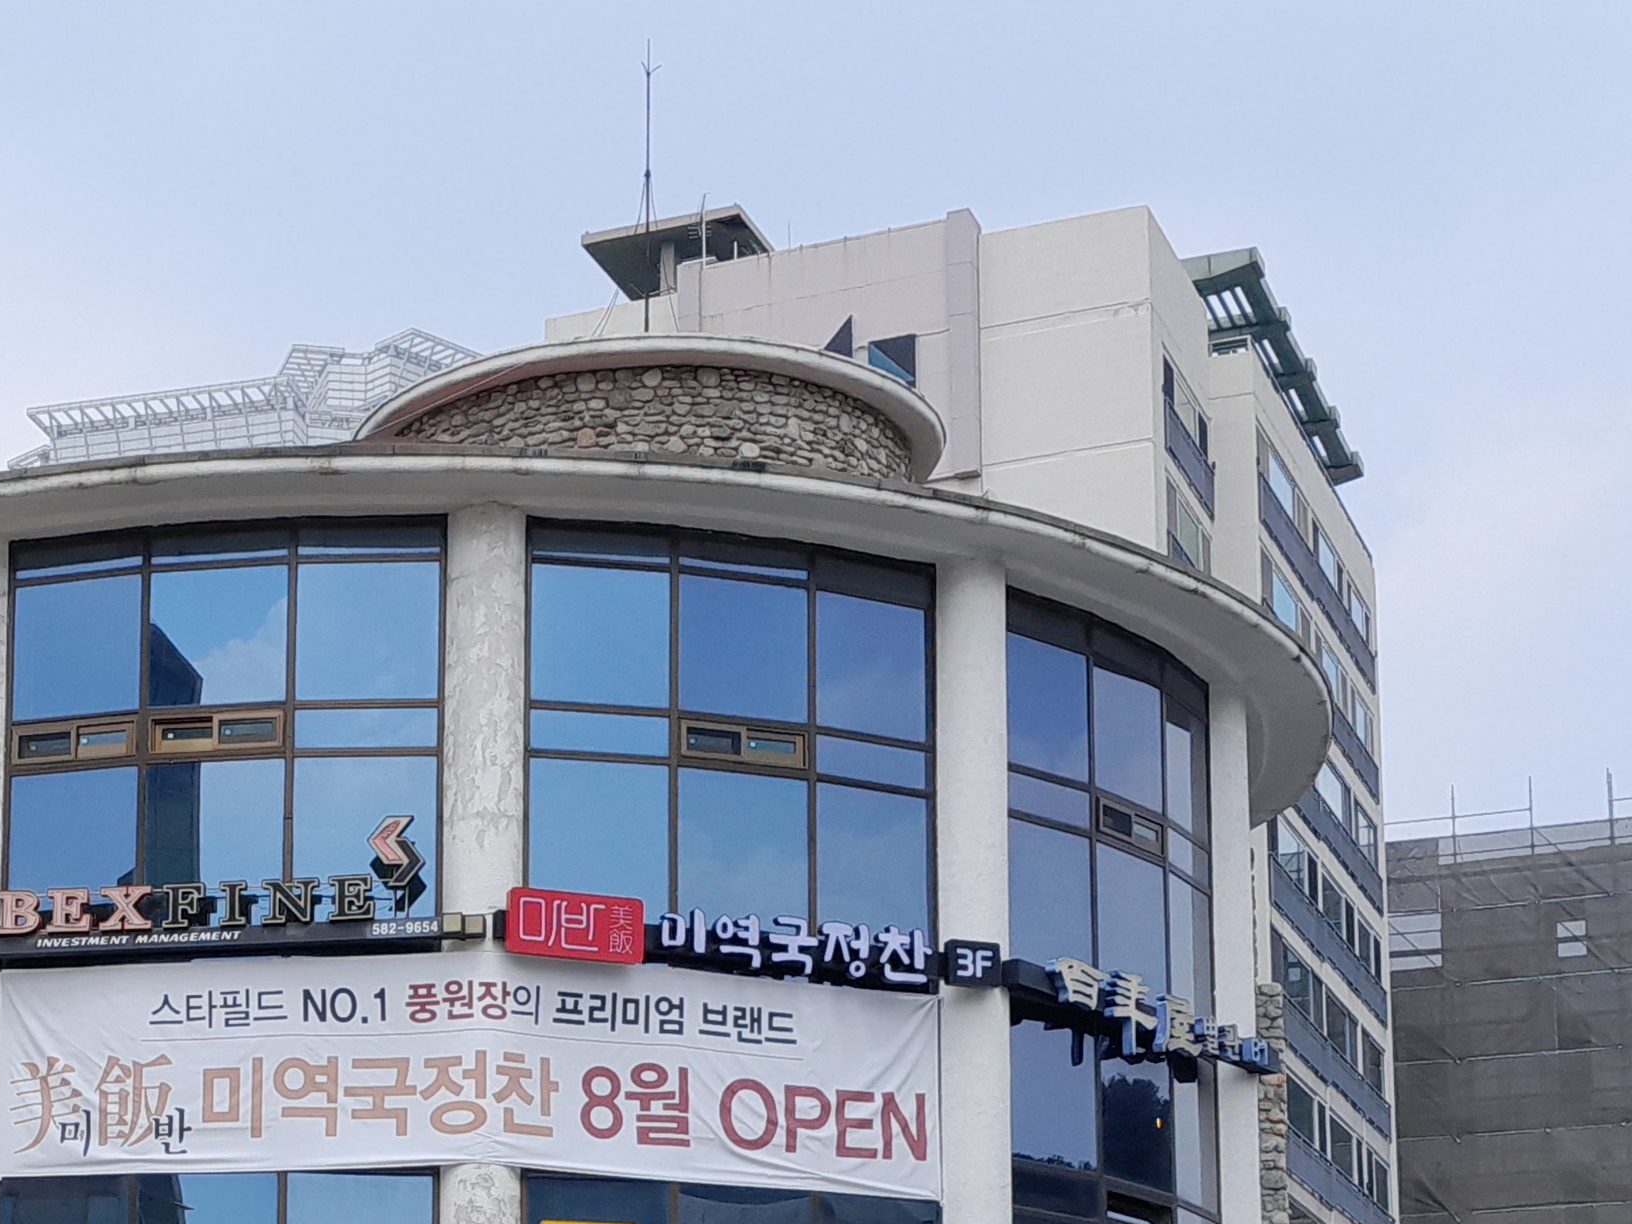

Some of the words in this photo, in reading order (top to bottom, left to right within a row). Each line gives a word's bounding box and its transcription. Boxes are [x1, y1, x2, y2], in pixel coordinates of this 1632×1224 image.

[36, 935, 129, 948] INVESTMENT
[134, 930, 241, 945] MANAGEMENT
[371, 920, 440, 936] 582-9654
[661, 908, 932, 982] 미역국정찬
[956, 948, 992, 979] 3F
[148, 987, 289, 1030] 스타필드
[301, 986, 388, 1024] NO.1
[404, 979, 541, 1025] 풍원장의
[552, 990, 685, 1036] 프리미엄
[698, 1002, 797, 1044] 브랜드
[201, 1050, 560, 1138] 미역국정찬
[579, 1062, 692, 1148] 8월
[719, 1078, 928, 1162] OPEN
